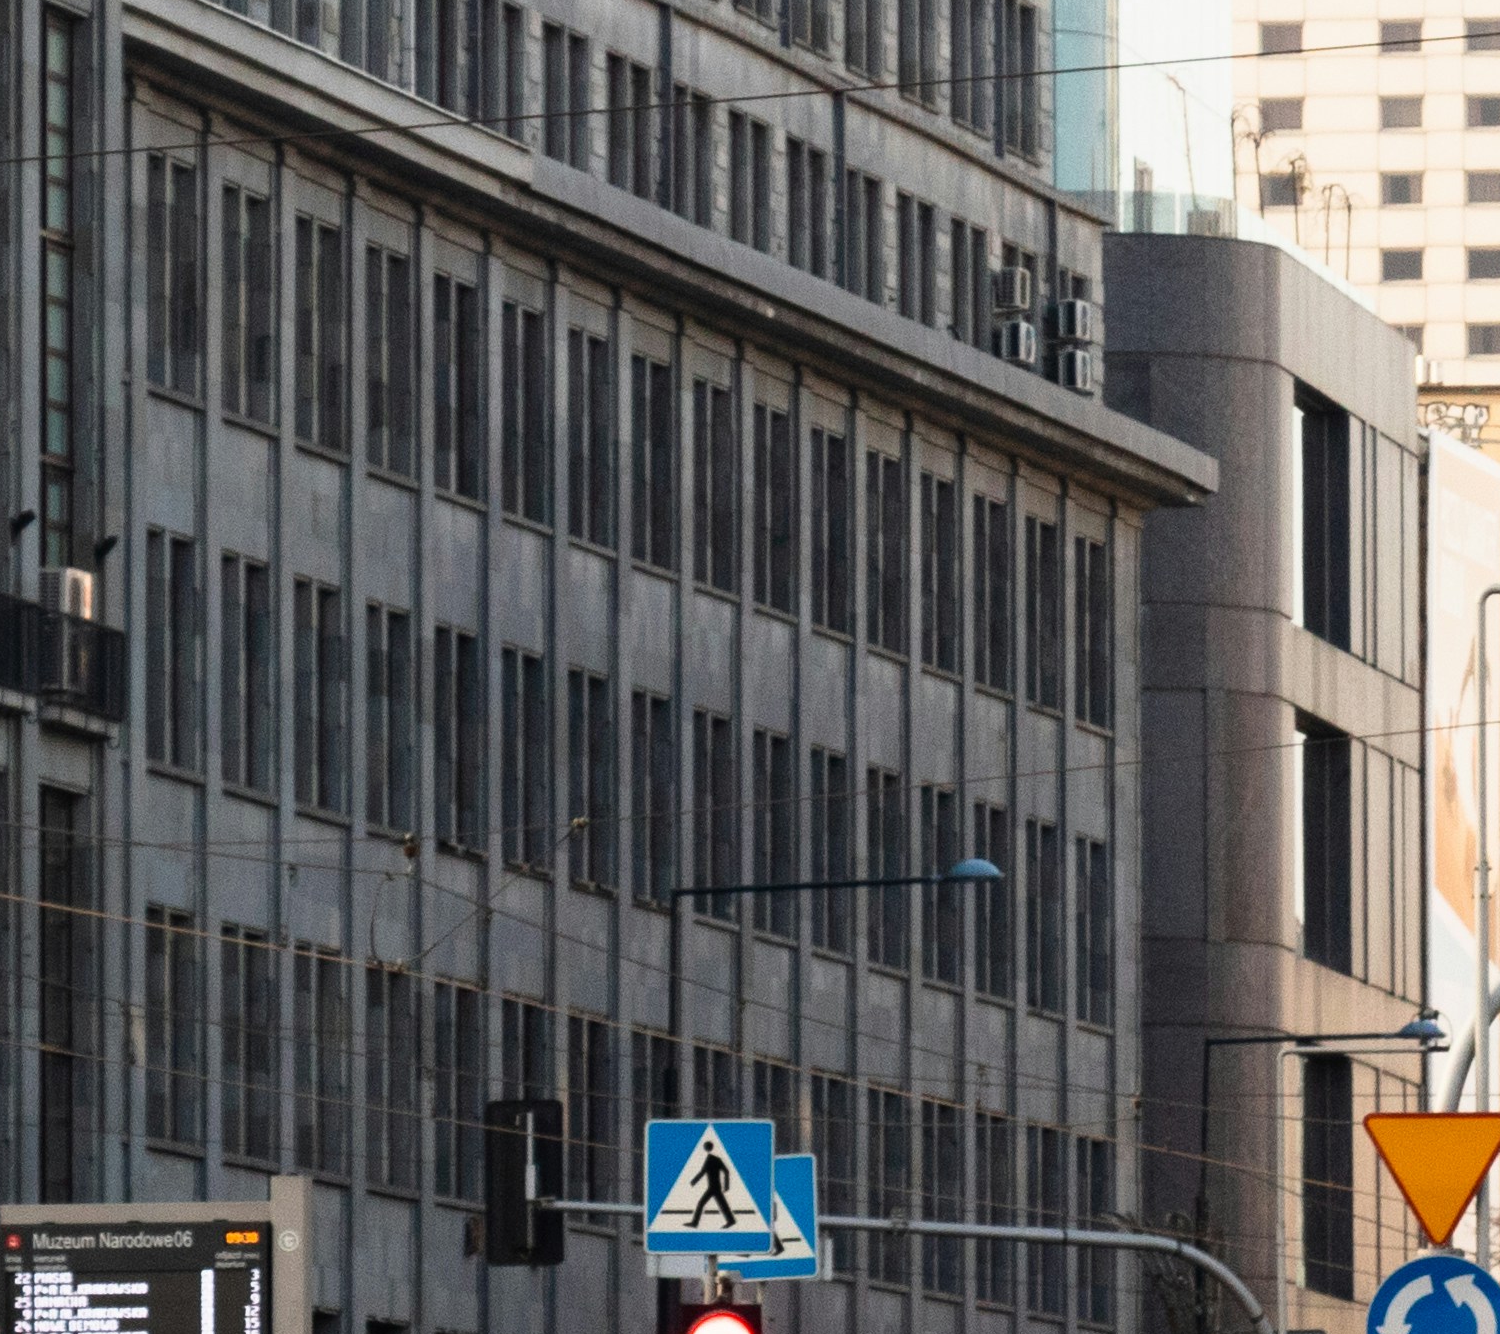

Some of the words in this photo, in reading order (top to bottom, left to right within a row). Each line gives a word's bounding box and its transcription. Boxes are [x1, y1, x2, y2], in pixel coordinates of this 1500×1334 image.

[33, 1233, 95, 1250] Muzeum
[14, 1272, 33, 1285] 22
[250, 1269, 260, 1281] 3
[22, 1284, 33, 1296] 9
[250, 1281, 260, 1293] 5
[14, 1296, 33, 1309] 25
[22, 1308, 33, 1320] 9
[244, 1305, 260, 1317] 12
